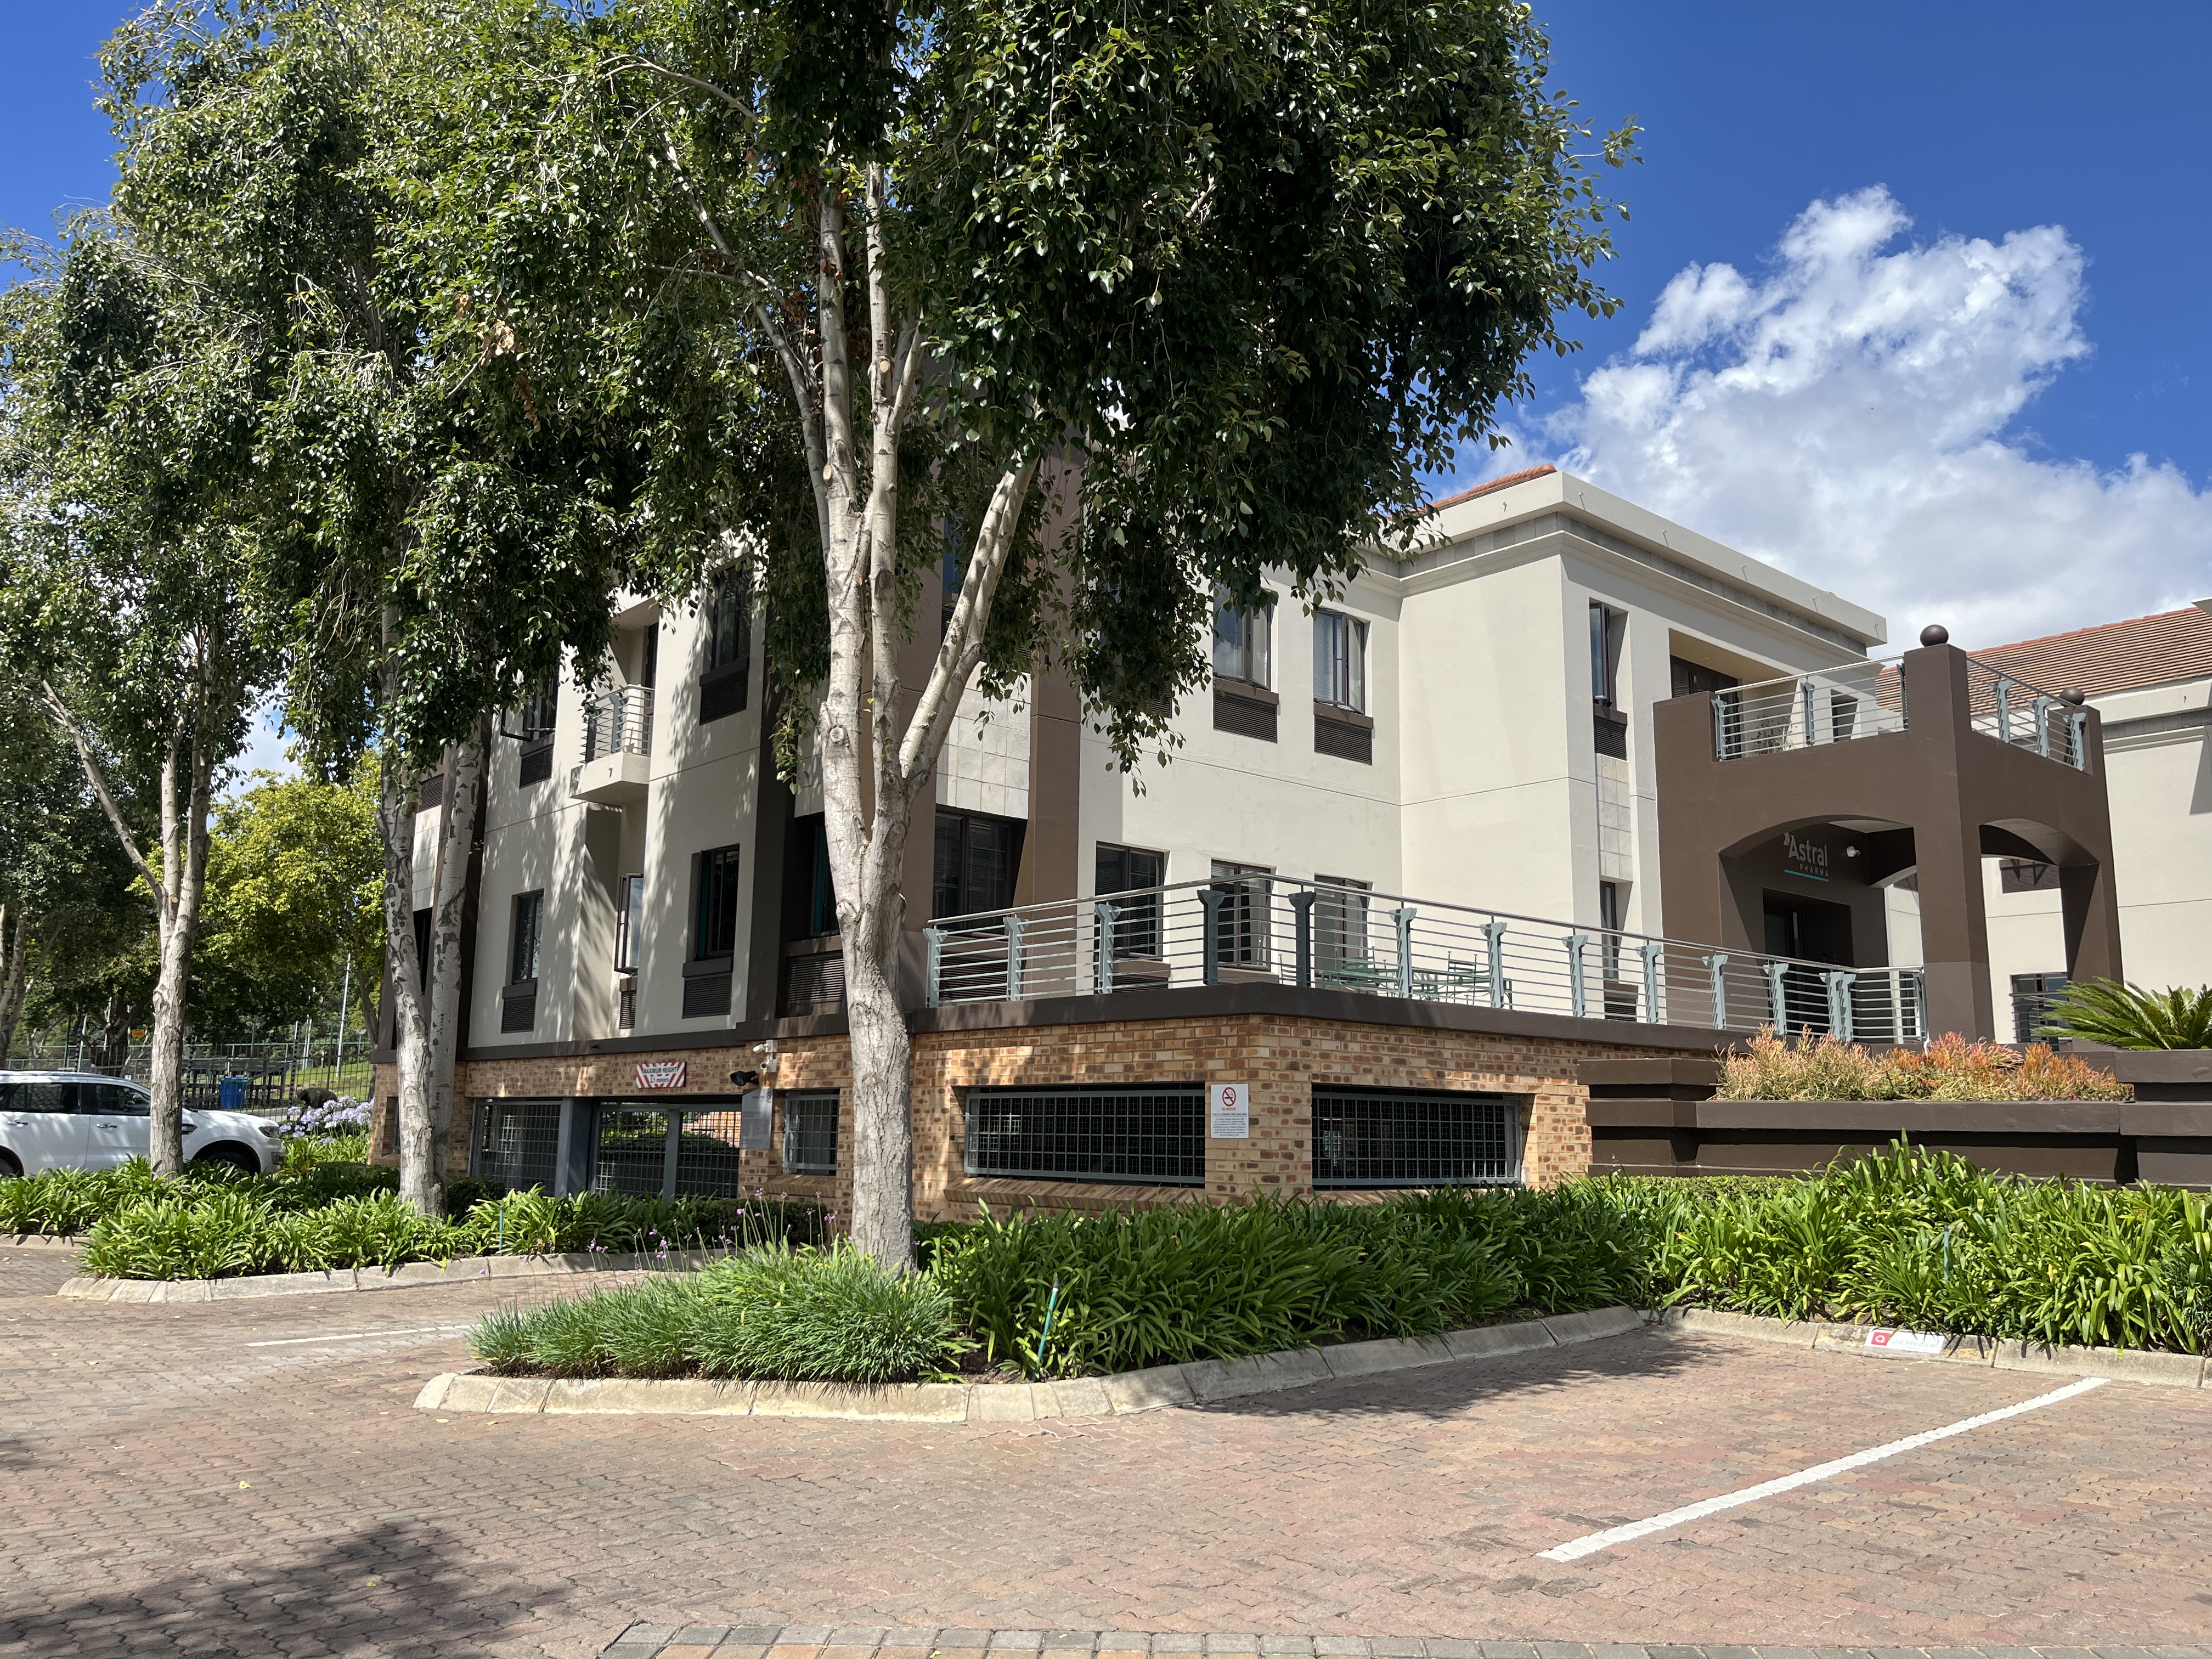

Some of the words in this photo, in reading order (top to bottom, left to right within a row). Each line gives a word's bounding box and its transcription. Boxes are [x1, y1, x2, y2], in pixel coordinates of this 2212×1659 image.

[1788, 835, 1827, 867] Astral
[1800, 864, 1829, 877] PHARMA
[1905, 1340, 1939, 1348] Medical
